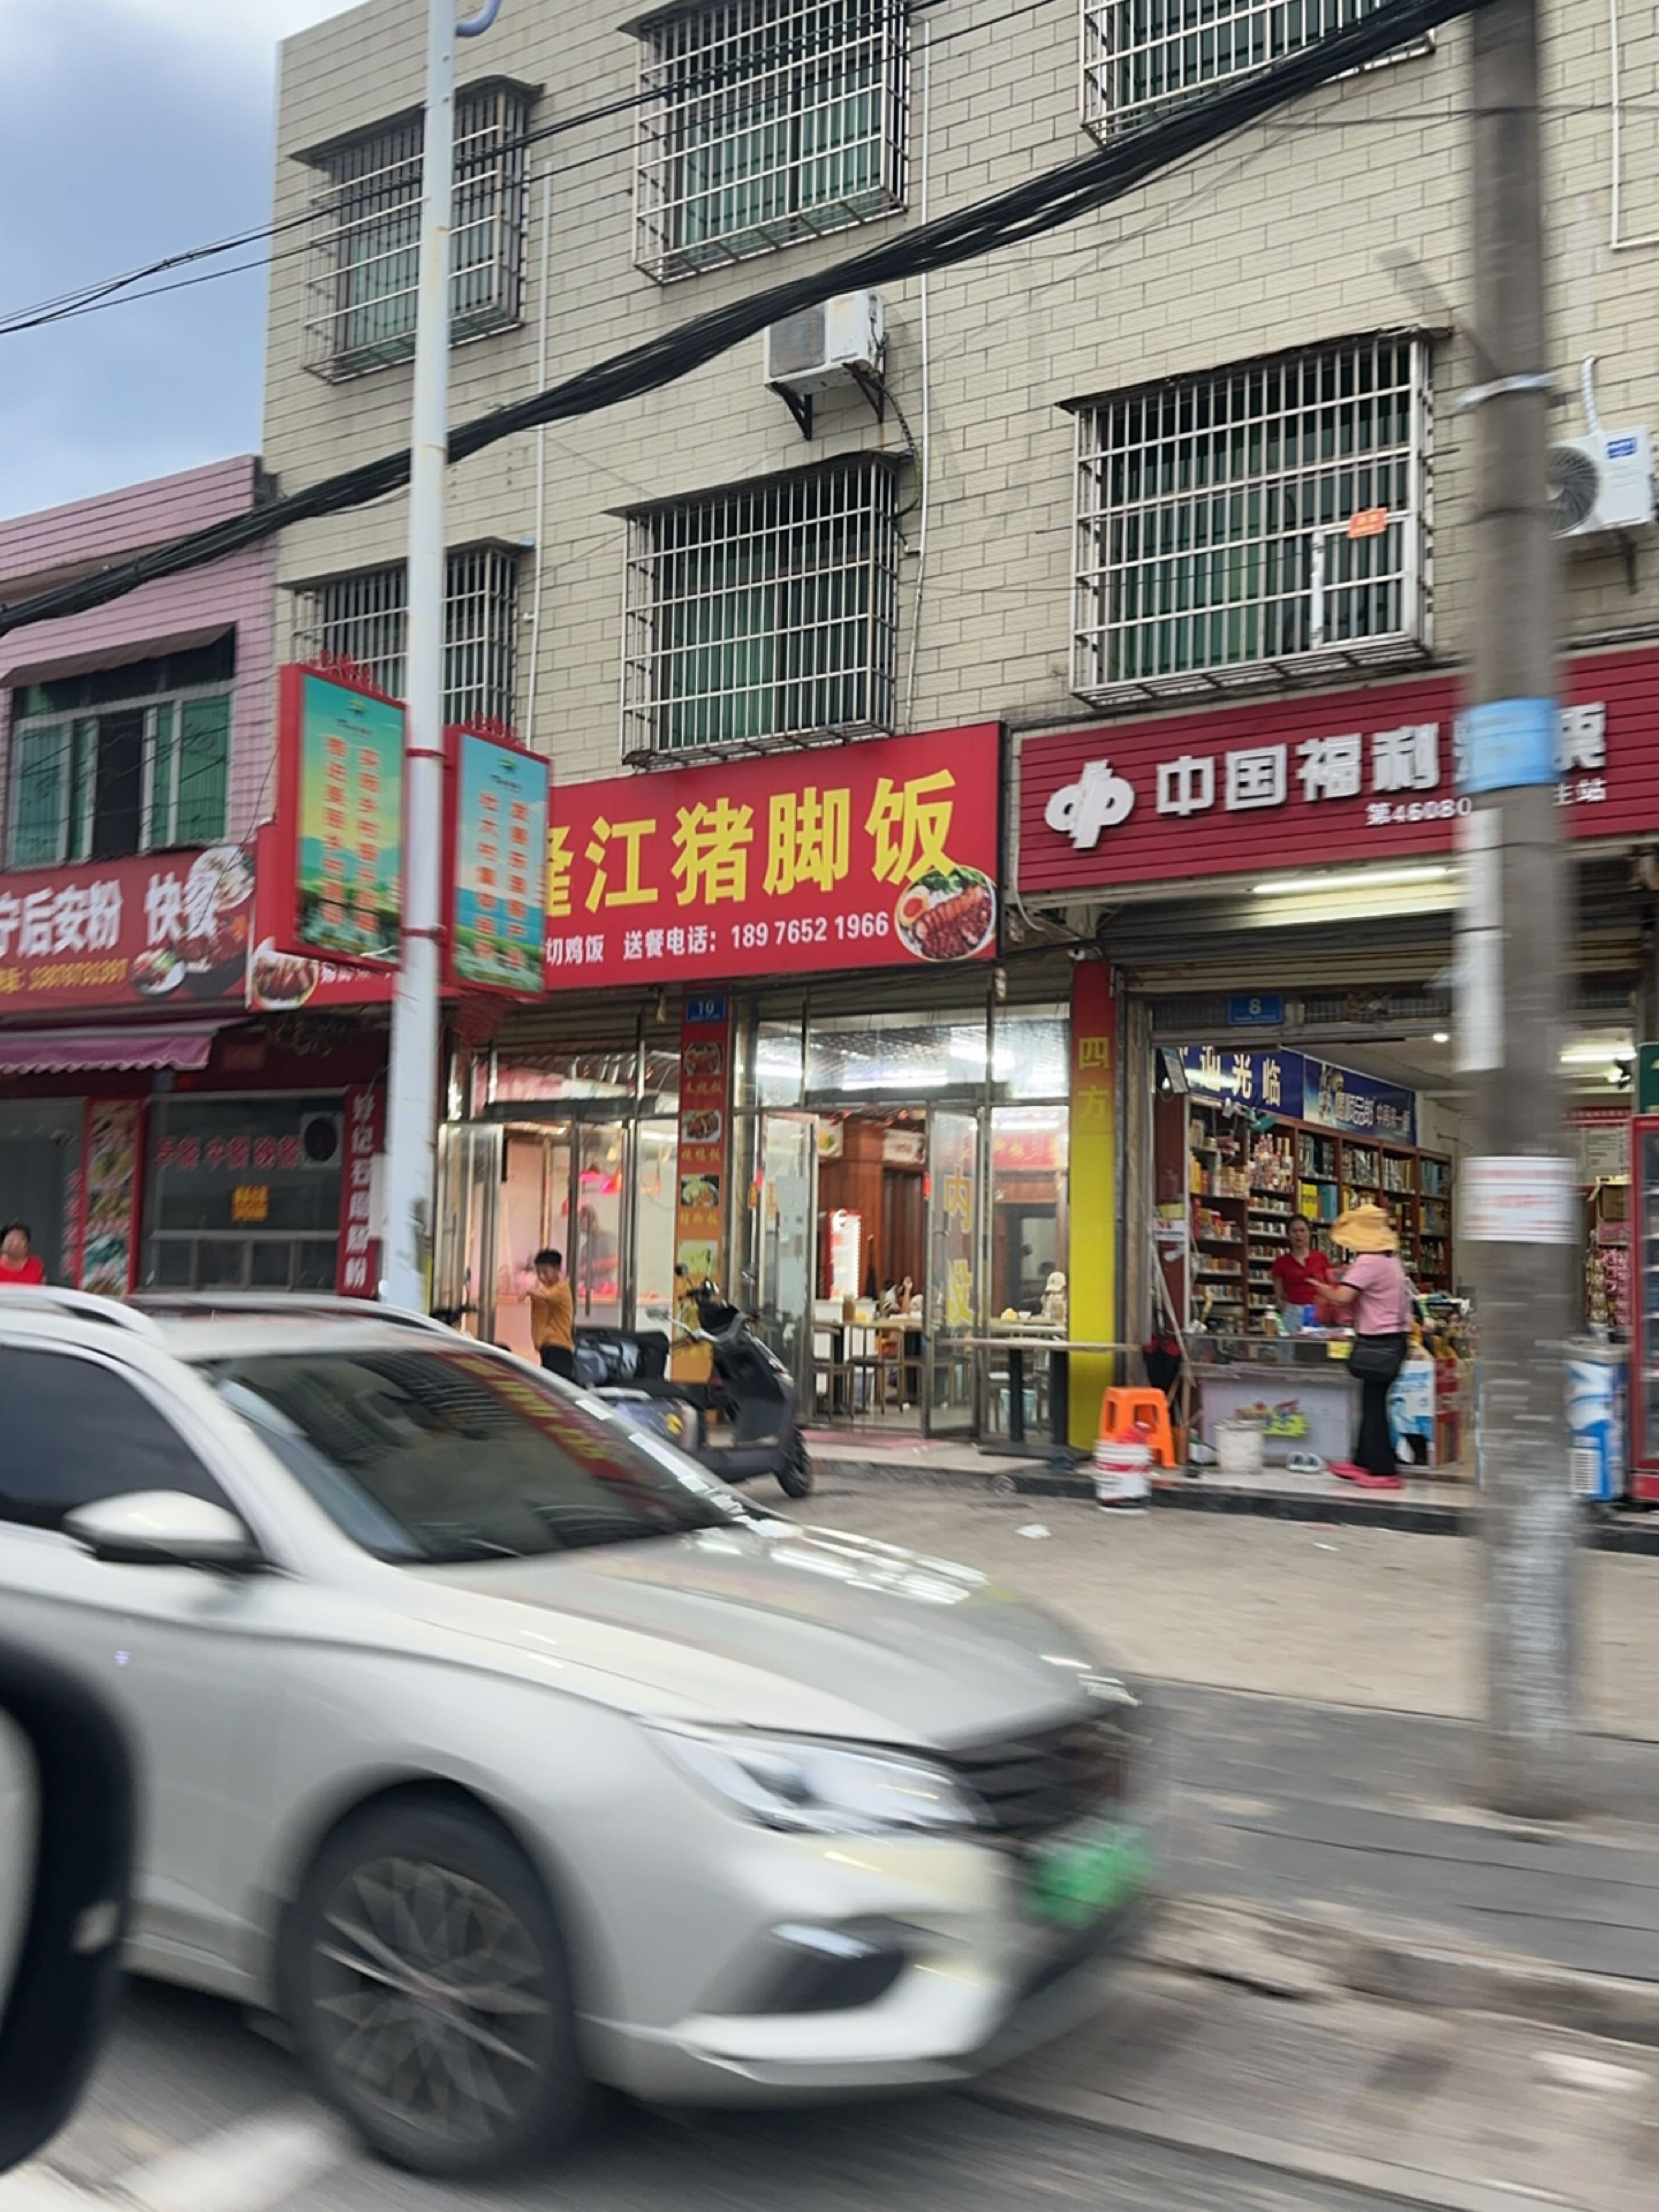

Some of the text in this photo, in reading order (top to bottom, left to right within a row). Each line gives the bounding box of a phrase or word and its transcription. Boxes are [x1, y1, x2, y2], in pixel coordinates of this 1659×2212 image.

[1156, 701, 1607, 818] 中国福利票
[730, 926, 769, 950] 189
[773, 917, 828, 946] 7652
[835, 911, 890, 940] 1966
[698, 1000, 716, 1015] 10
[1249, 998, 1262, 1014] 8
